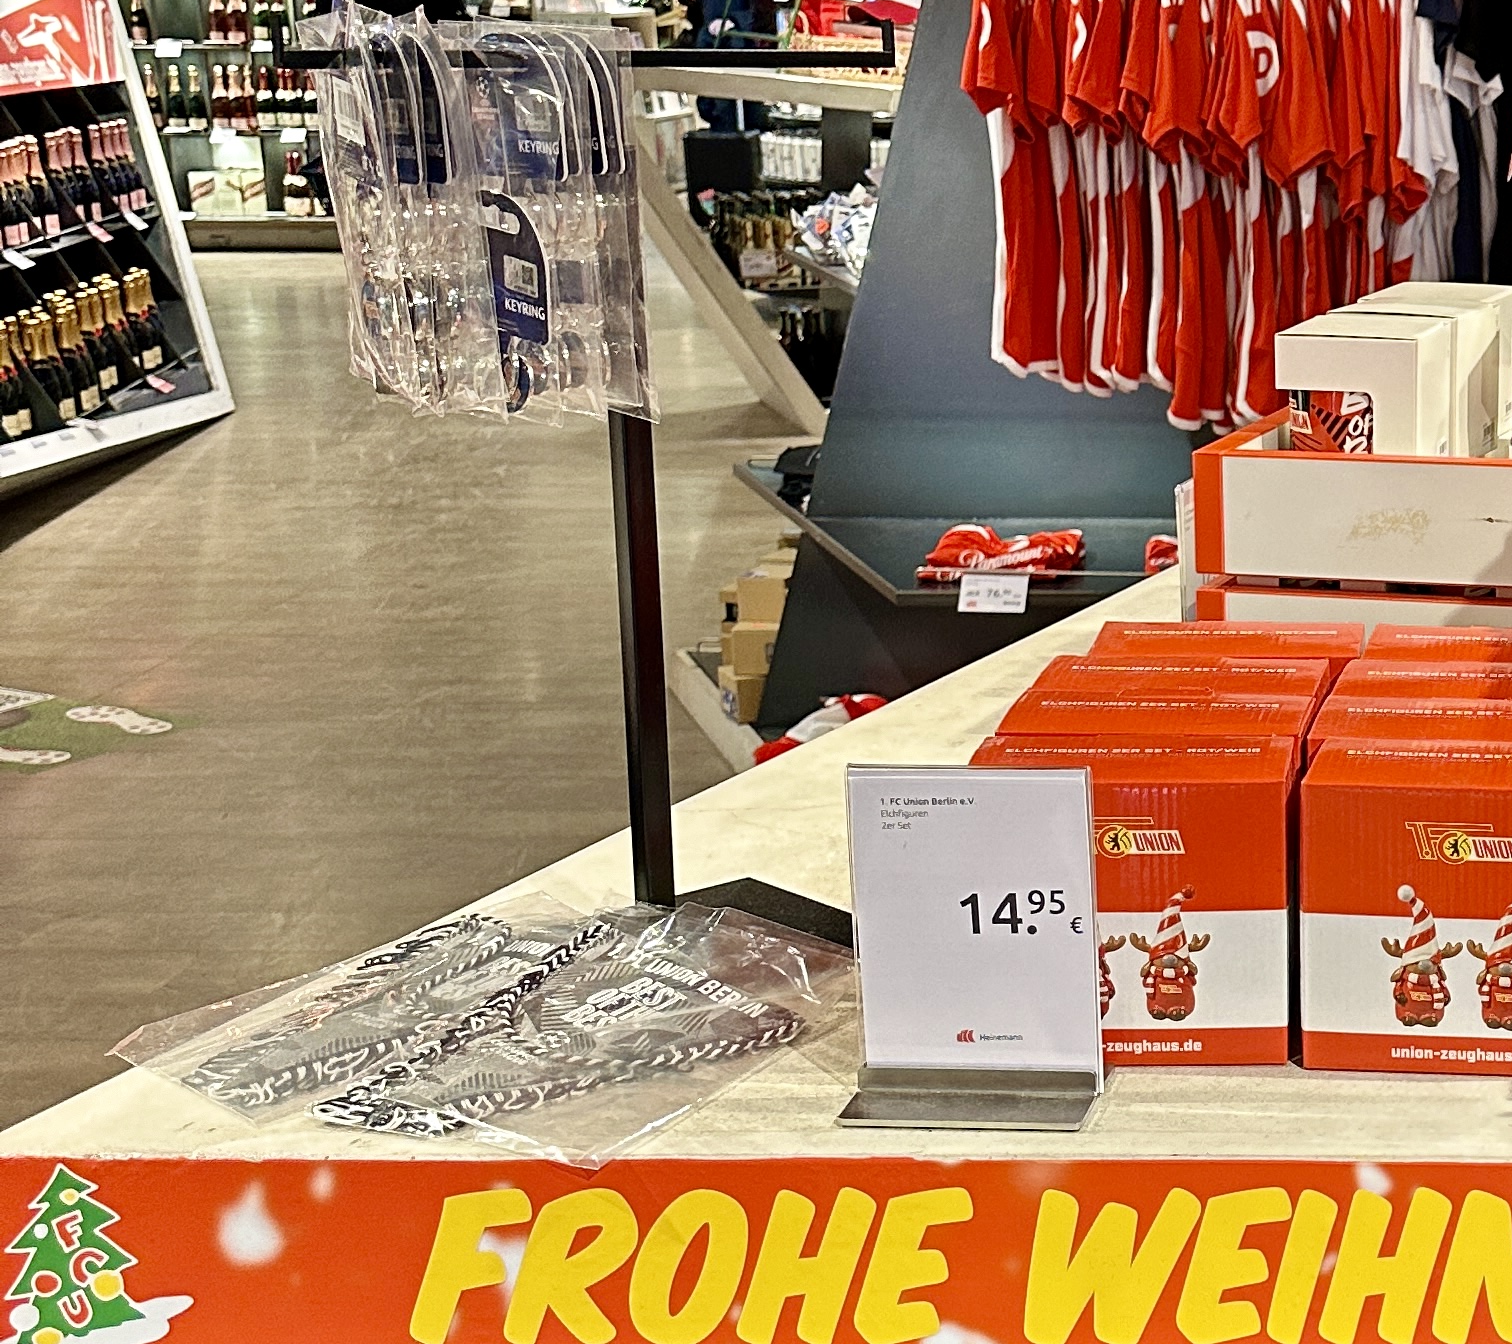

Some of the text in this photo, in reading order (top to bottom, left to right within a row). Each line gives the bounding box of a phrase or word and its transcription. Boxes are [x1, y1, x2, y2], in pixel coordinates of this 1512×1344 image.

[517, 139, 560, 156] KEYRING
[504, 296, 546, 321] KEYRING
[890, 797, 958, 806] FC Union Berlin
[881, 821, 911, 830] 2er Set
[1132, 832, 1182, 852] UNION
[960, 890, 1066, 935] 14.95
[649, 958, 769, 1019] UNION BERLIN
[1101, 1039, 1203, 1053] -zeughaus.de
